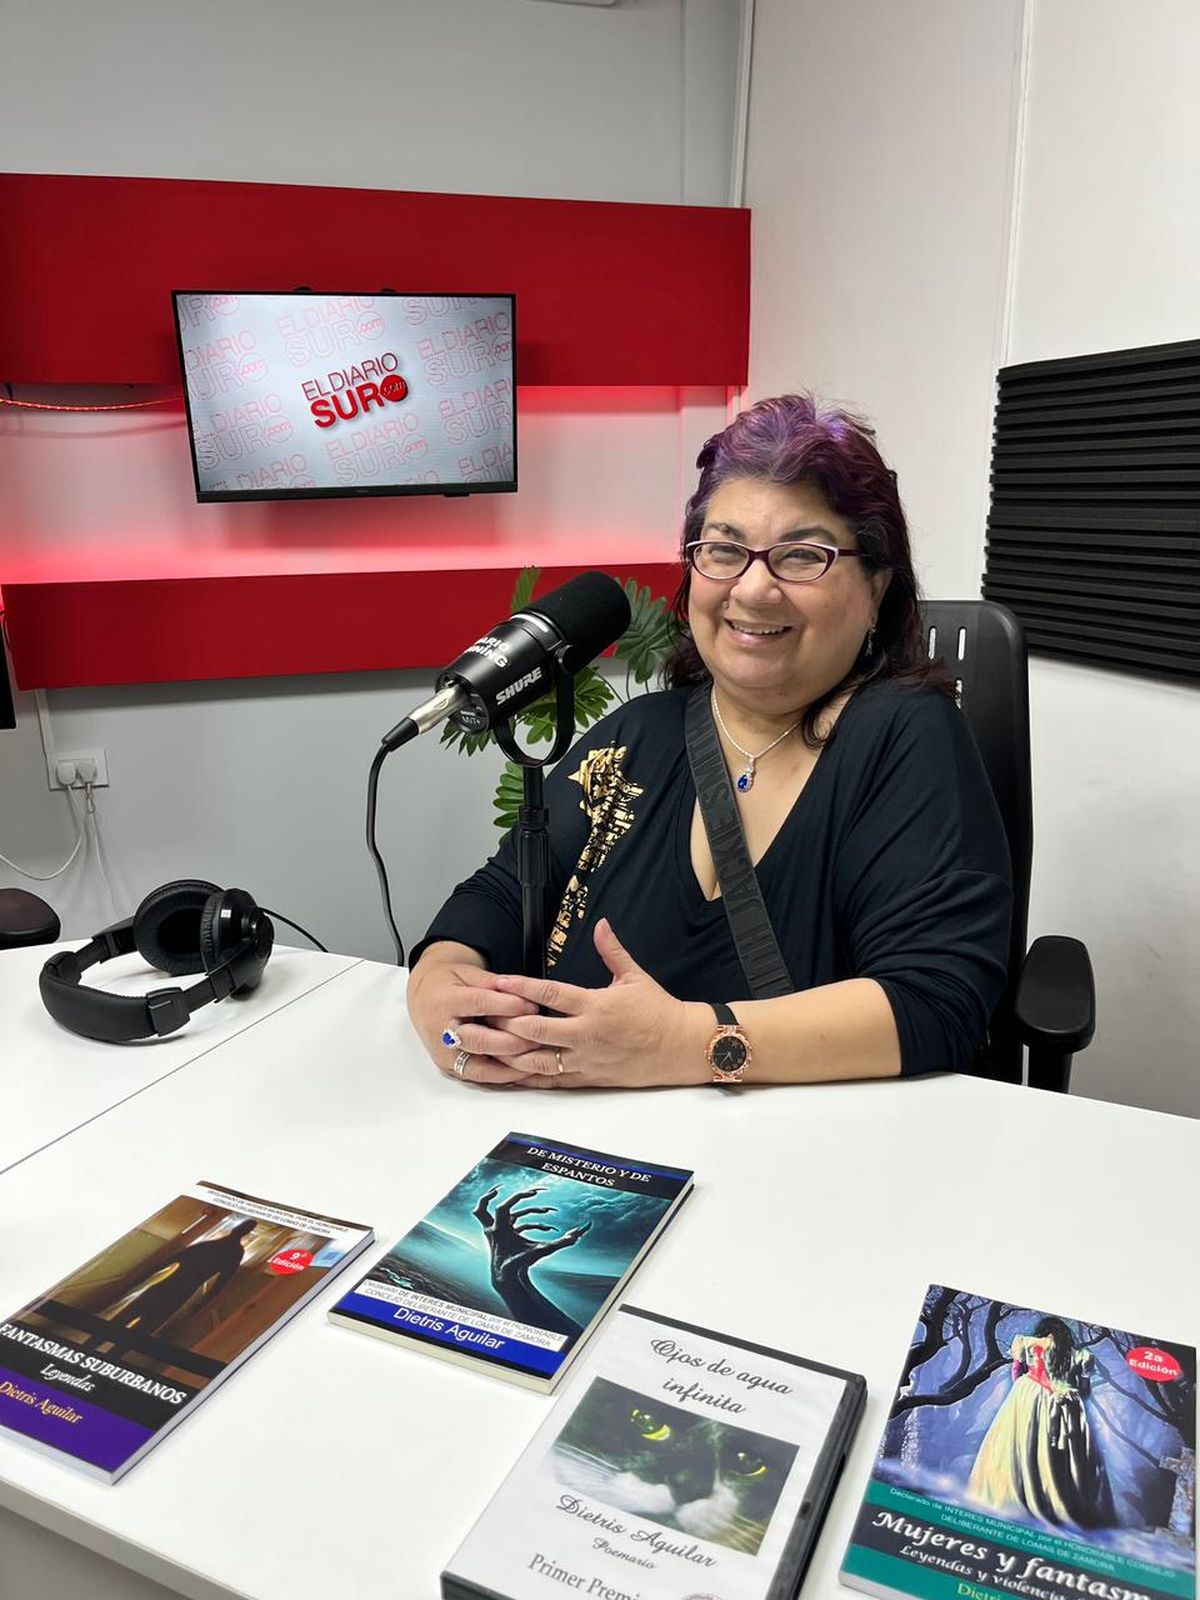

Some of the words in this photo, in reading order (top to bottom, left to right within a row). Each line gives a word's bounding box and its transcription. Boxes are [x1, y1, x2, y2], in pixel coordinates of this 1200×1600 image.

[495, 667, 542, 705] SHURE
[527, 1147, 548, 1158] DE
[548, 1152, 617, 1175] MISTERIO
[618, 1169, 630, 1178] Y
[630, 1172, 652, 1182] DE
[541, 1162, 615, 1187] ESPANTOS
[271, 1257, 305, 1272] Edición
[393, 1307, 445, 1331] Dietris
[445, 1322, 505, 1349] Aguilar
[0, 1323, 83, 1364] FANTASMAS
[80, 1356, 187, 1404] SUBURBANOS
[40, 1363, 95, 1392] Leyendas
[651, 1340, 706, 1367] Ojos
[707, 1359, 735, 1376] de
[736, 1372, 792, 1394] agua
[1129, 1359, 1177, 1376] Edición
[0, 1381, 37, 1405] Dietris
[36, 1399, 83, 1423] Aguilar
[662, 1378, 746, 1413] infinita
[556, 1494, 626, 1534] Dietris
[630, 1530, 717, 1567] Aguilar
[872, 1512, 988, 1560] Mujeres
[995, 1552, 1016, 1573] y
[528, 1553, 586, 1589] Primer
[592, 1537, 657, 1570] Poemario
[900, 1545, 973, 1575] Leyendas
[976, 1570, 988, 1583] y
